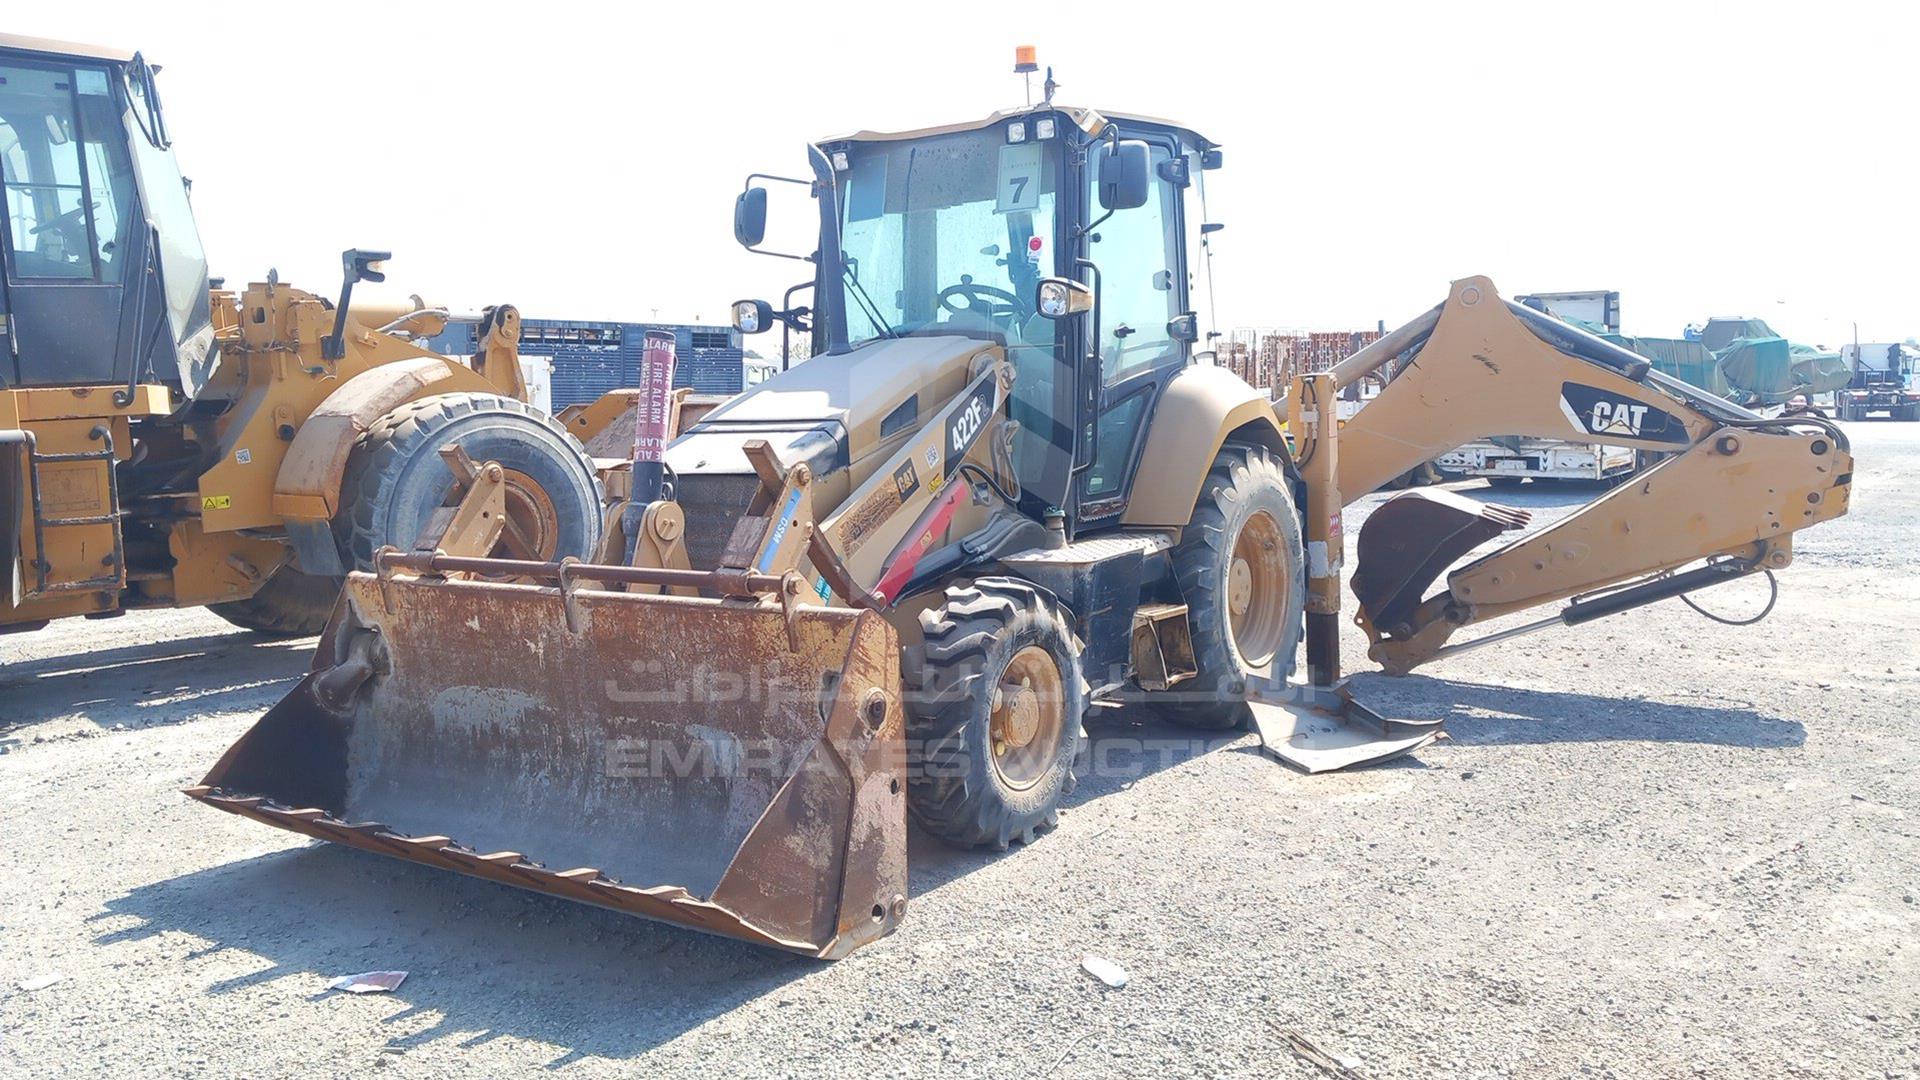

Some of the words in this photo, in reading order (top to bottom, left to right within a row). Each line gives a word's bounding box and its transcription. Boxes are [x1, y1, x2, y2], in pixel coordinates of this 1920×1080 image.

[1009, 176, 1029, 204] 7
[652, 361, 664, 385] FIRE
[651, 387, 662, 424] ALARM
[1591, 401, 1649, 437] CAT
[897, 466, 915, 494] CAT
